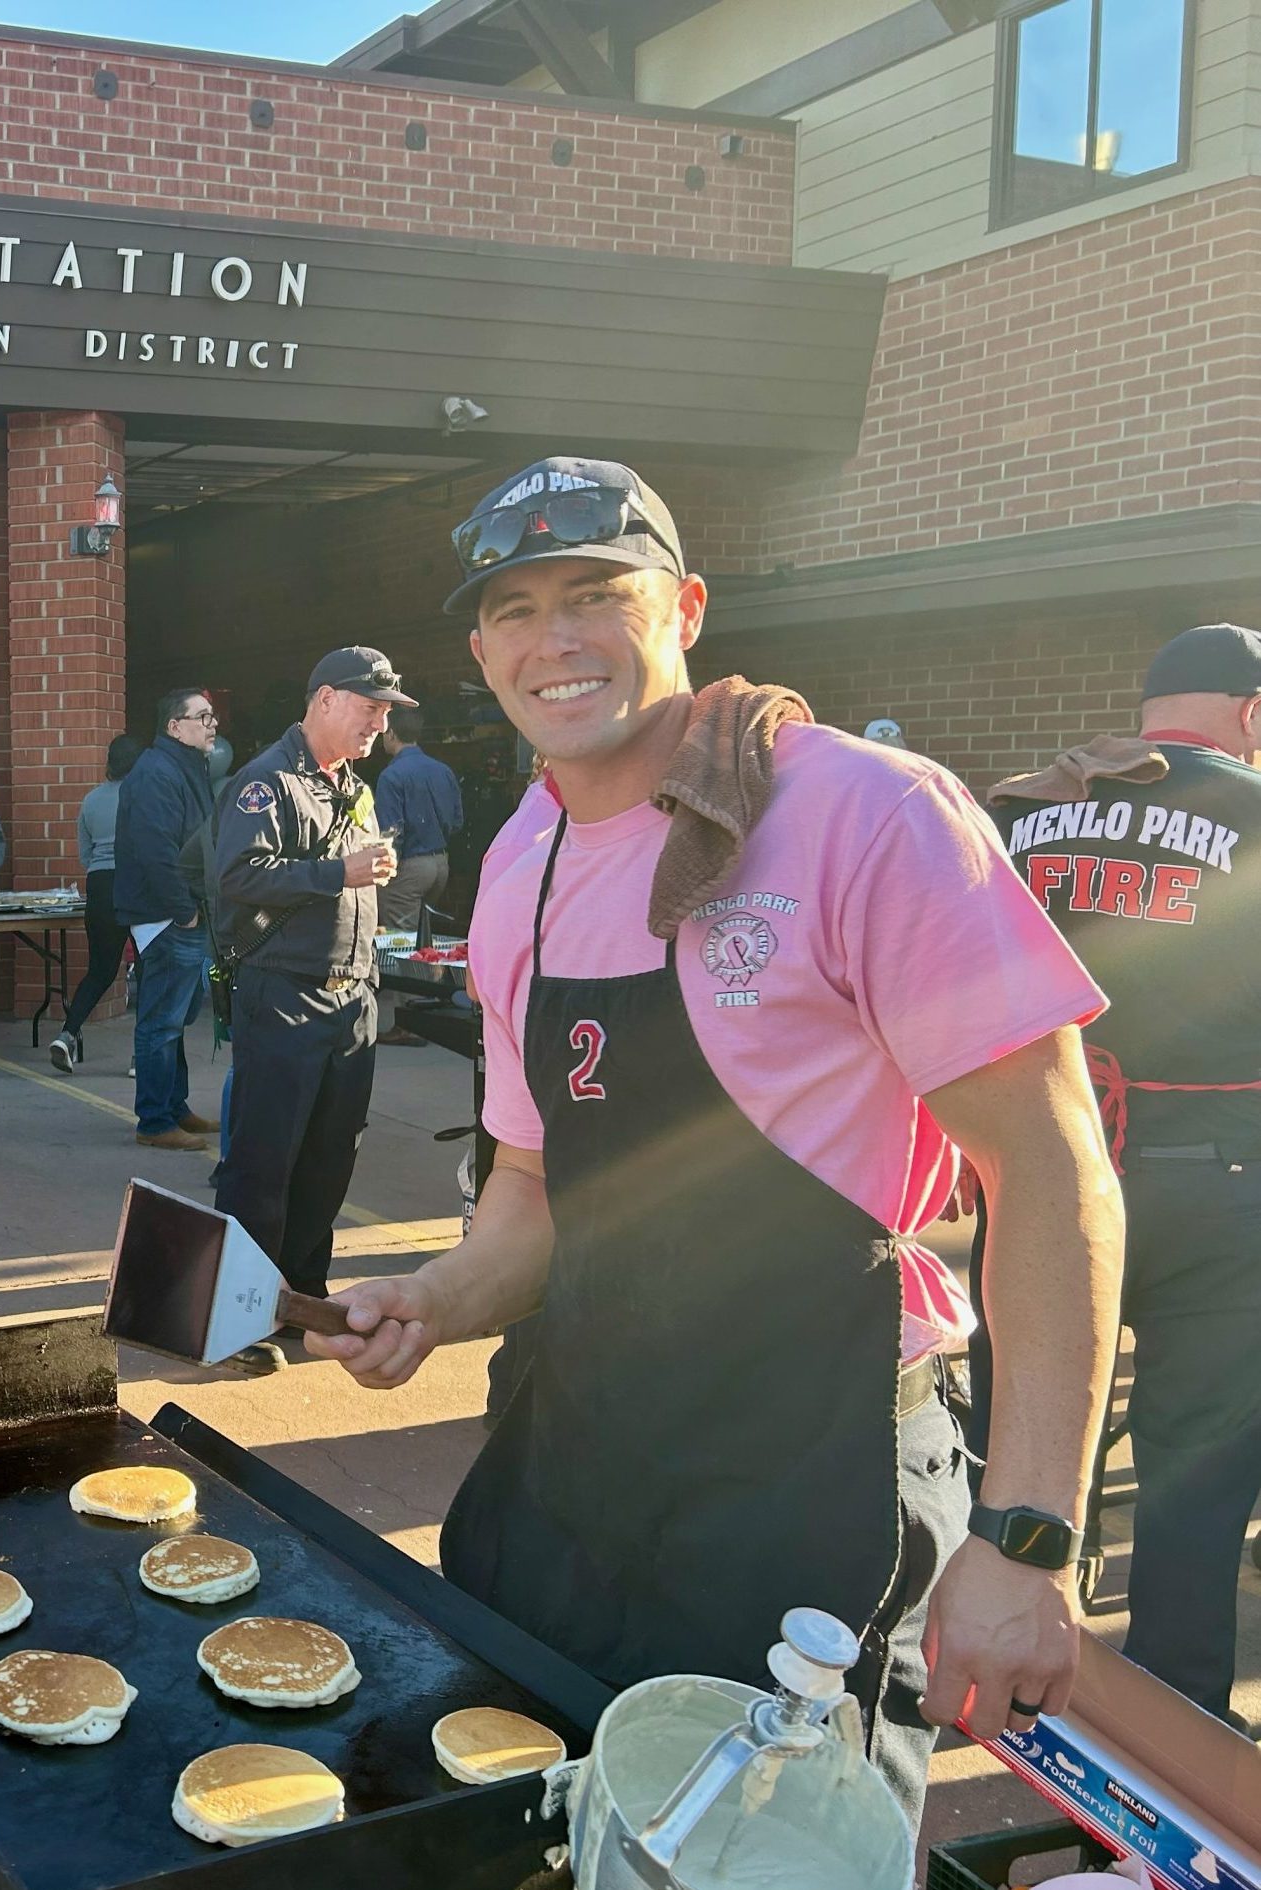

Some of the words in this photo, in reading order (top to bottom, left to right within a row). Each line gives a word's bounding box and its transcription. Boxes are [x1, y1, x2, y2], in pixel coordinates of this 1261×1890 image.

[85, 329, 299, 371] DISTRICT
[1009, 800, 1133, 857] MENLO
[1137, 804, 1239, 875] PARK
[690, 892, 748, 921] MENLO
[751, 891, 801, 916] PARK
[1026, 853, 1202, 925] FIRE
[714, 989, 760, 1009] FIRE
[567, 1019, 607, 1102] 2
[1042, 1754, 1126, 1830] Foodservice
[1107, 1780, 1157, 1824] KIRKLAND
[1129, 1824, 1157, 1857] Foil
